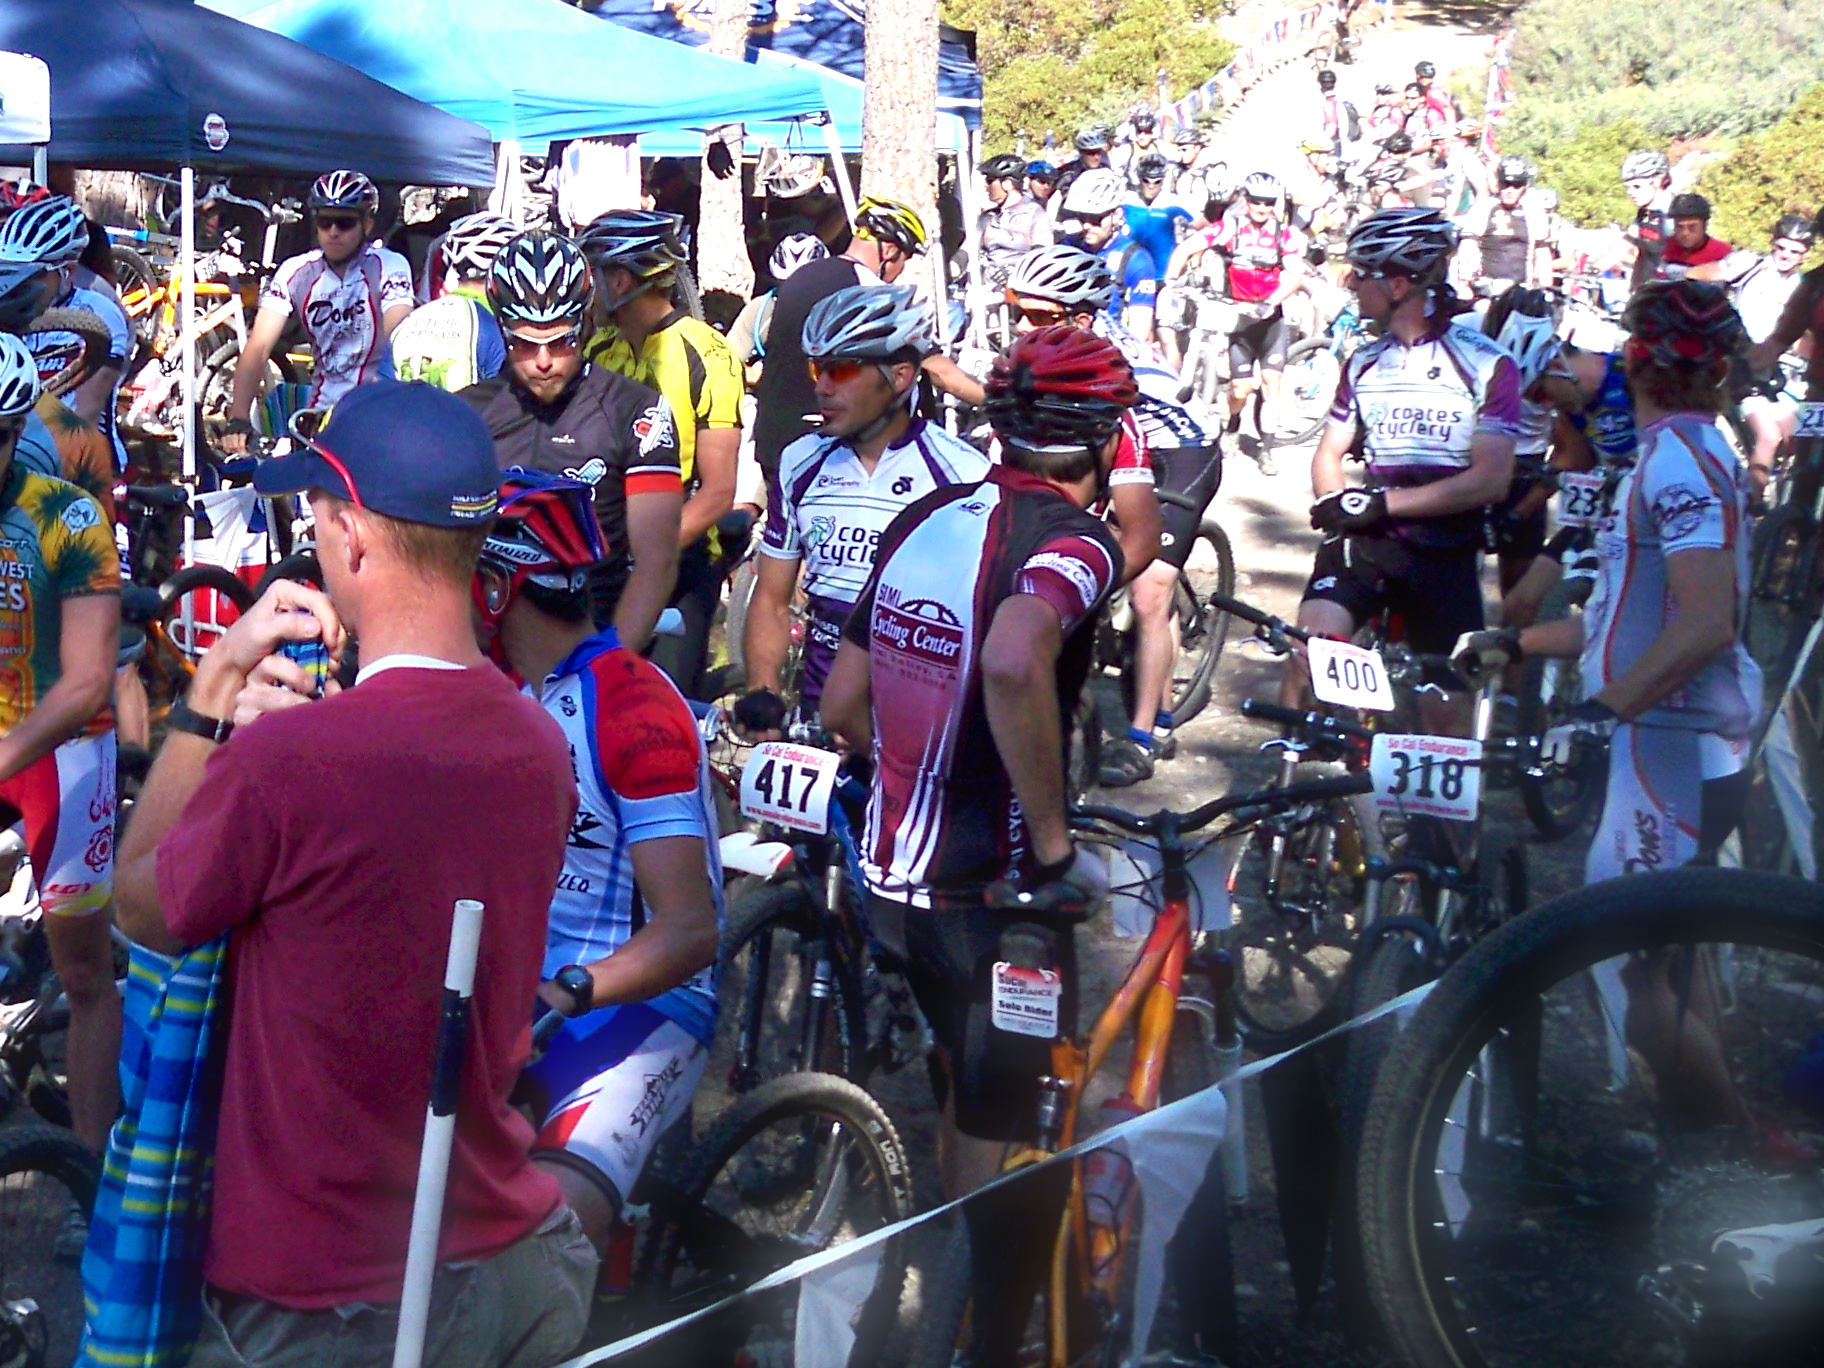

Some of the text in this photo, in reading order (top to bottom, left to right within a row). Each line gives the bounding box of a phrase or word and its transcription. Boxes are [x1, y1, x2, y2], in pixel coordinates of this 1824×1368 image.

[1392, 406, 1462, 423] coates
[838, 525, 883, 545] coa
[874, 608, 910, 650] Cycling
[913, 626, 962, 658] Center
[1327, 656, 1378, 693] 400
[755, 759, 820, 813] 417
[1387, 750, 1464, 801] 318
